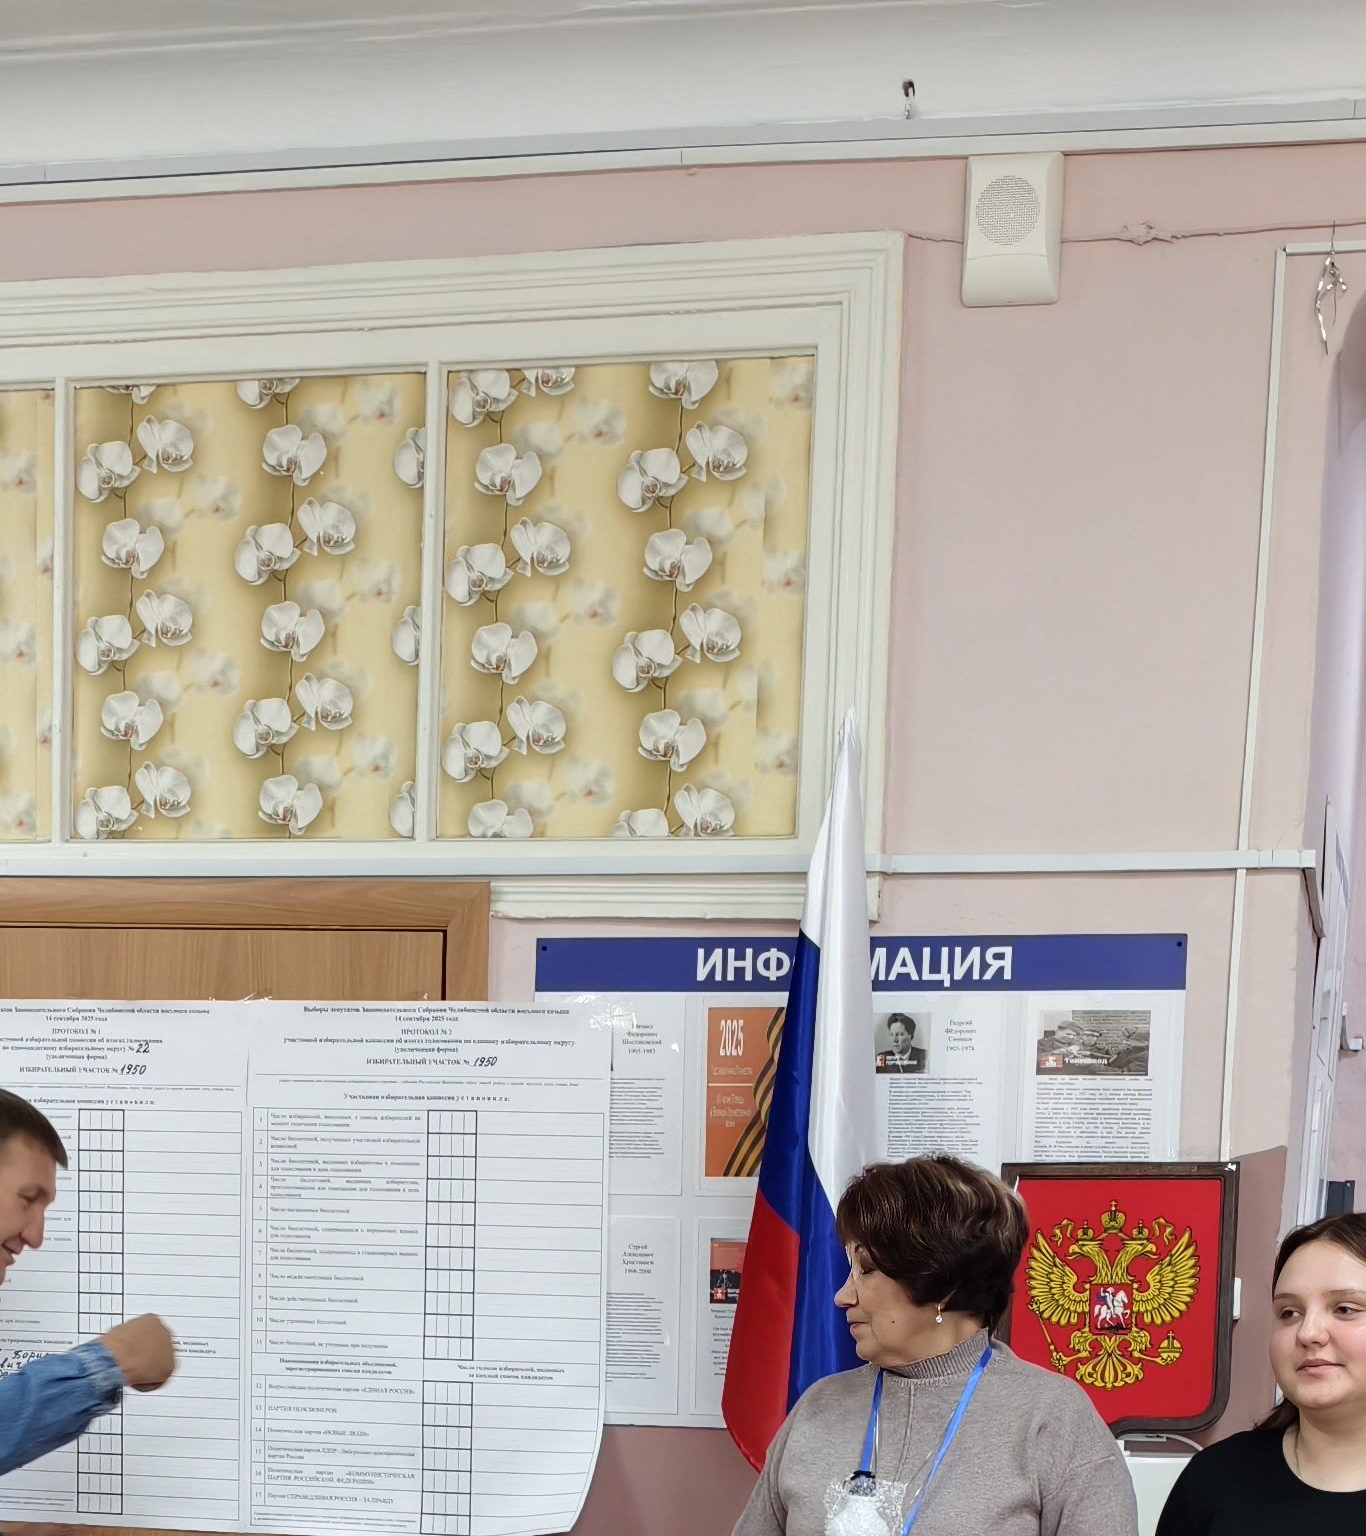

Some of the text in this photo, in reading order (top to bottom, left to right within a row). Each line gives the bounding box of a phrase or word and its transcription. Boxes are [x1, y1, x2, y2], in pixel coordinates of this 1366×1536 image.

[696, 946, 1013, 987] ИНФМАЦИЯ
[720, 1019, 744, 1056] 2025
[135, 1042, 150, 1053] 22
[473, 1056, 498, 1067] 1950
[120, 1063, 147, 1075] 1950
[12, 1350, 49, 1363] Бори
